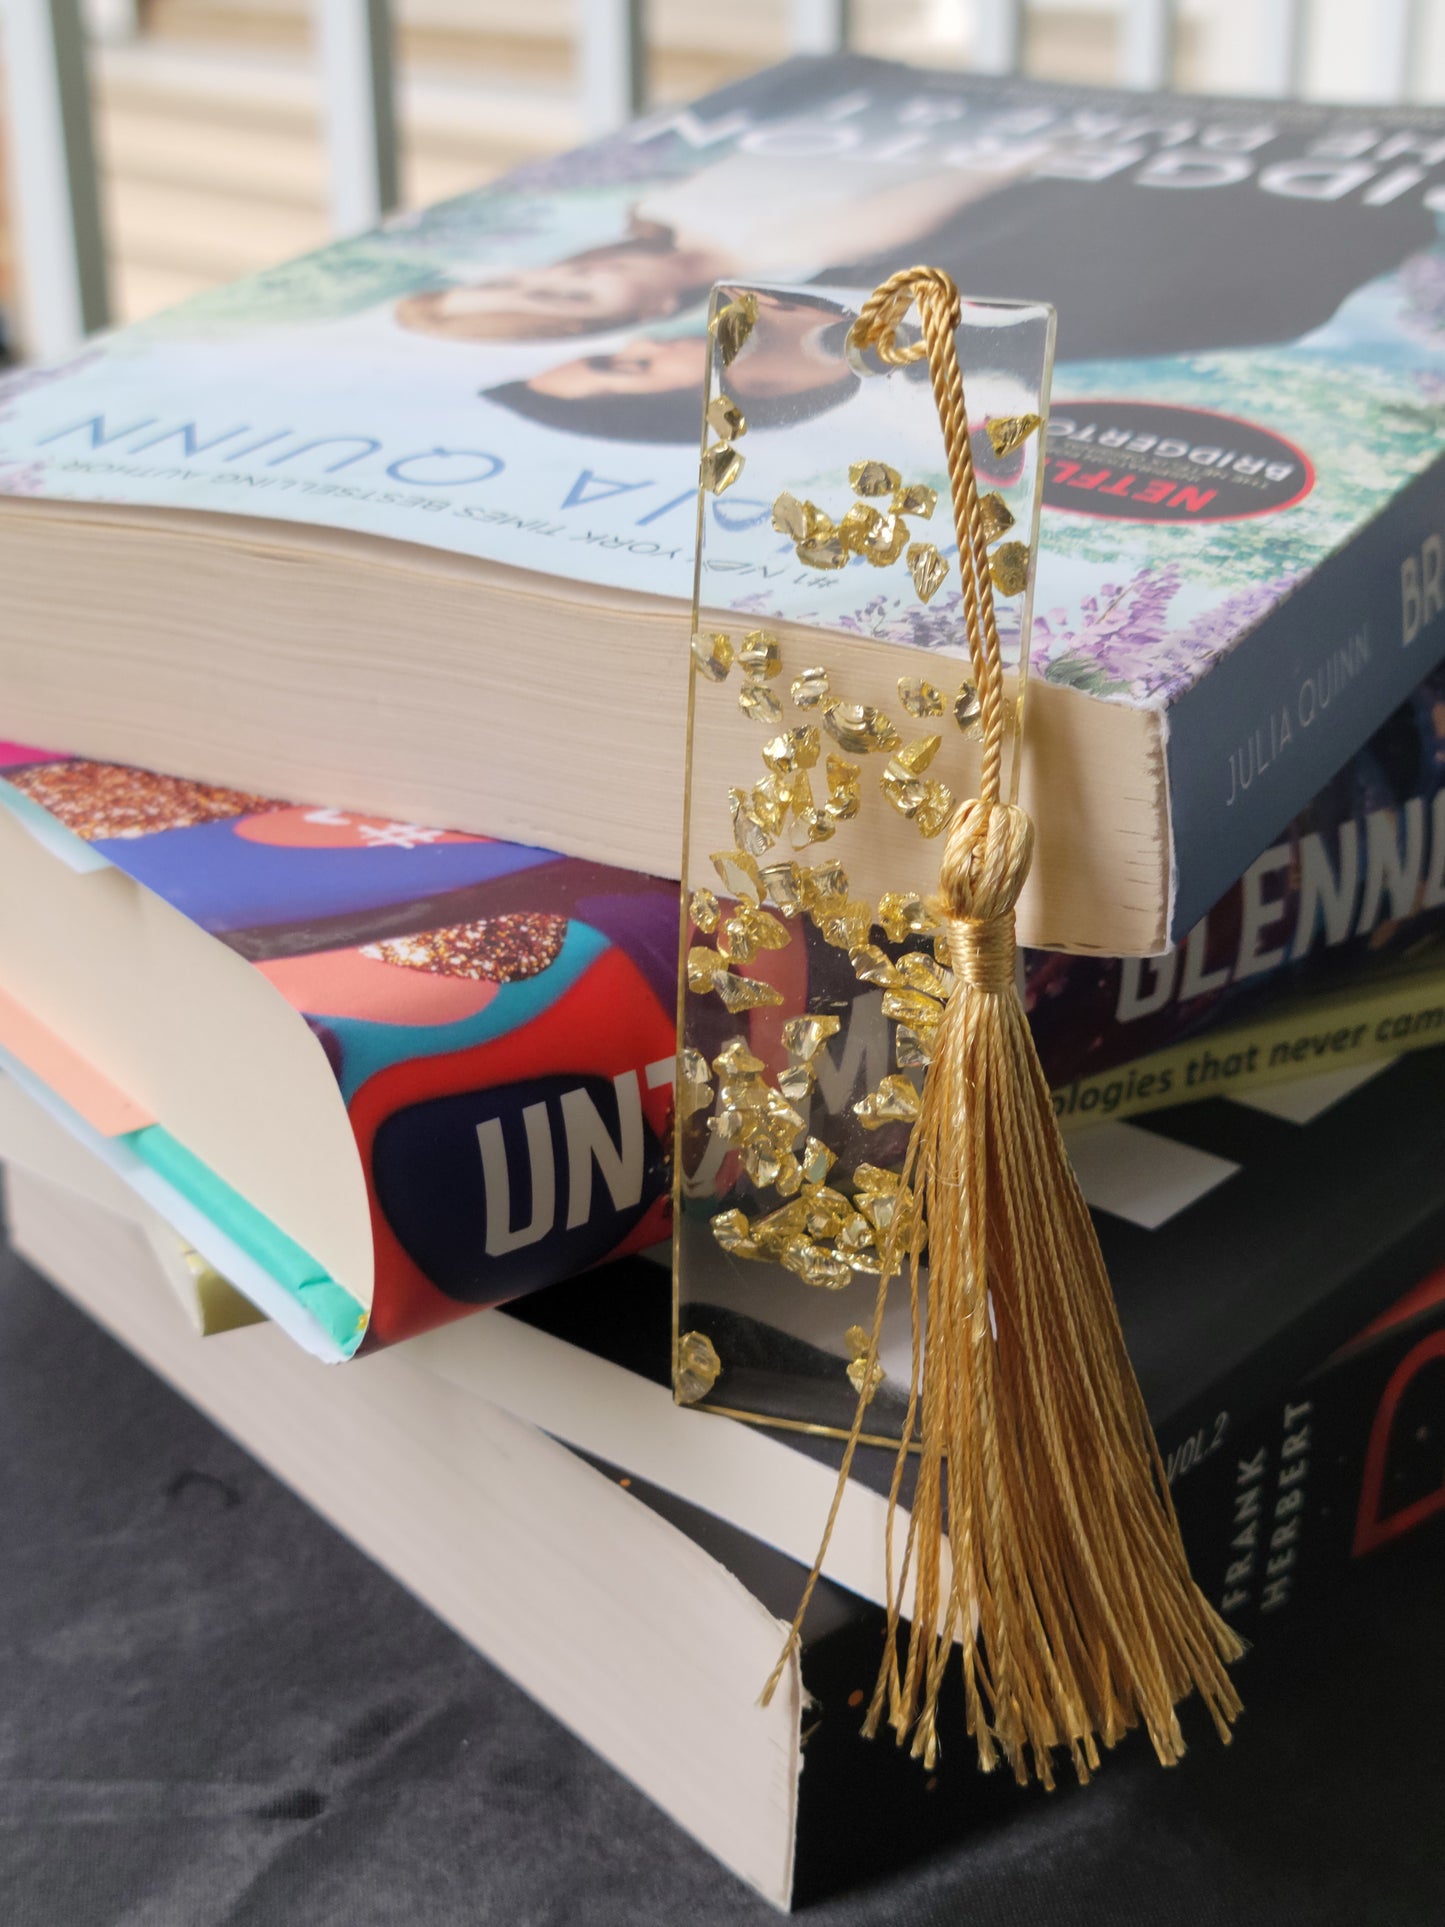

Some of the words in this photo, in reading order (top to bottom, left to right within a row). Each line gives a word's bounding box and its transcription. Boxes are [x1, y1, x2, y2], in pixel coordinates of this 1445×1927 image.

[630, 107, 1445, 213] IDGERTON
[35, 412, 506, 488] QUINN
[1044, 456, 1219, 513] NETFL
[1047, 416, 1295, 482] BRIDGERTO
[210, 471, 452, 512] BESTSELLING
[453, 505, 567, 537] TIMES
[569, 530, 683, 560] YORK
[1226, 704, 1292, 806] JULIA
[1299, 621, 1371, 738] QUINN
[1052, 1066, 1173, 1117] ologies
[1185, 1042, 1259, 1087] that
[1267, 1022, 1367, 1068] never
[1220, 1446, 1266, 1611] FRANK
[1260, 1400, 1313, 1611] HERBERT
